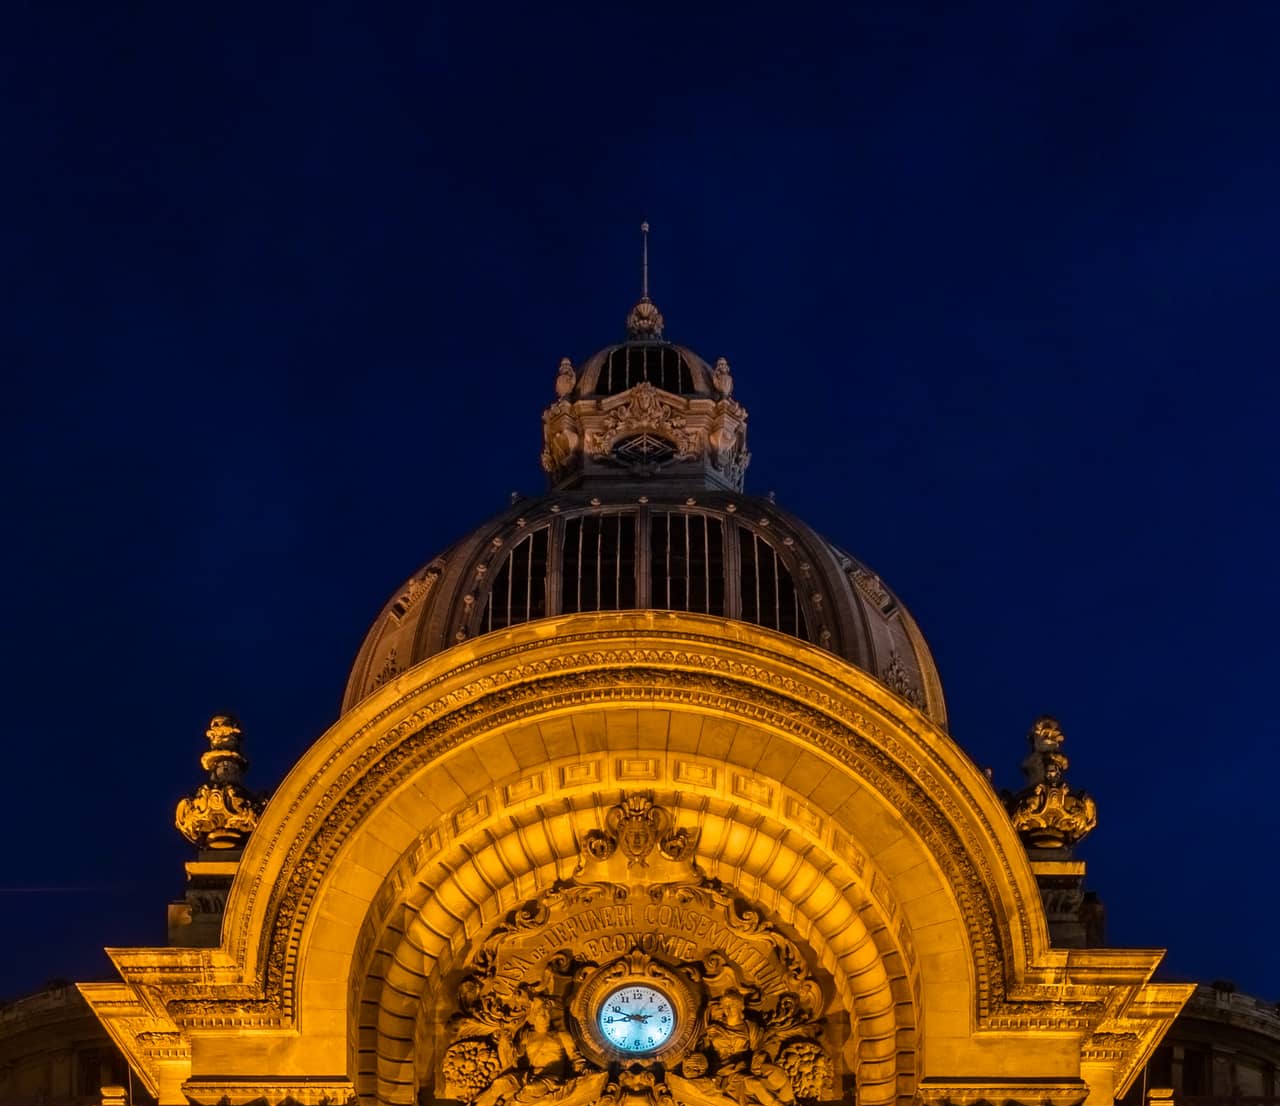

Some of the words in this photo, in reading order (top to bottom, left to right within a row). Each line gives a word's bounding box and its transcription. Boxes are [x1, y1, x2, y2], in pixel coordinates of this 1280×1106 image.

[531, 944, 546, 960] DE
[543, 903, 634, 948] DEPUNERI
[583, 931, 697, 960] ECONOMIE
